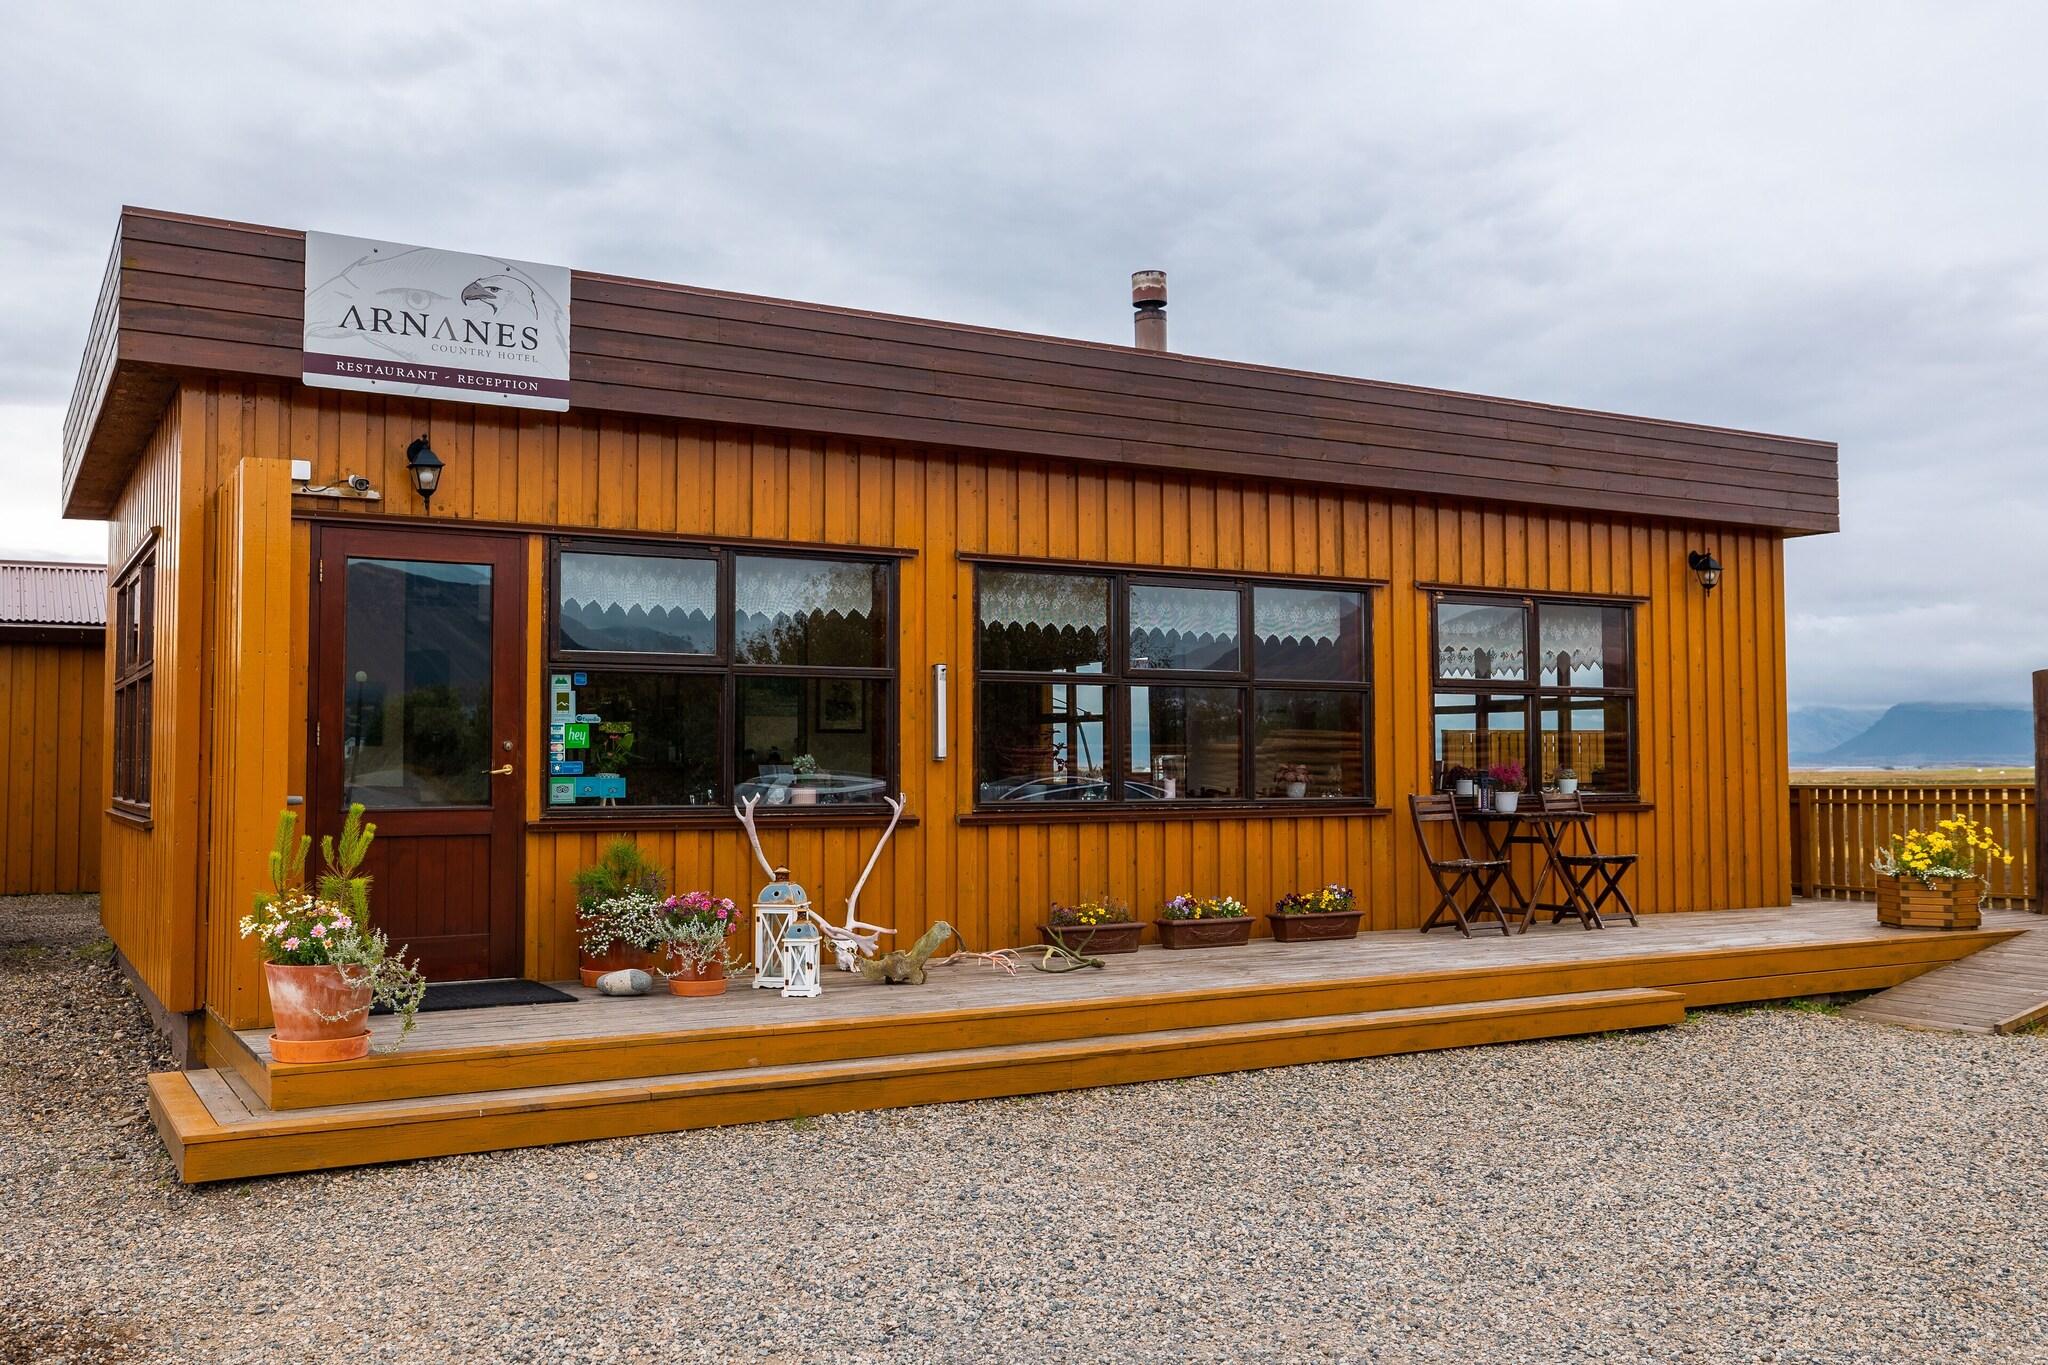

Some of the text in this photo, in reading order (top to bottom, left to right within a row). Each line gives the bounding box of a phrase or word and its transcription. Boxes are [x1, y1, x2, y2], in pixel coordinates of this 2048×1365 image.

[338, 304, 539, 351] ARNANES
[431, 344, 538, 363] COUNTRY HOTEL
[336, 360, 438, 381] RESTAURANT
[457, 374, 539, 391] RECEPTION
[568, 726, 586, 745] hey
